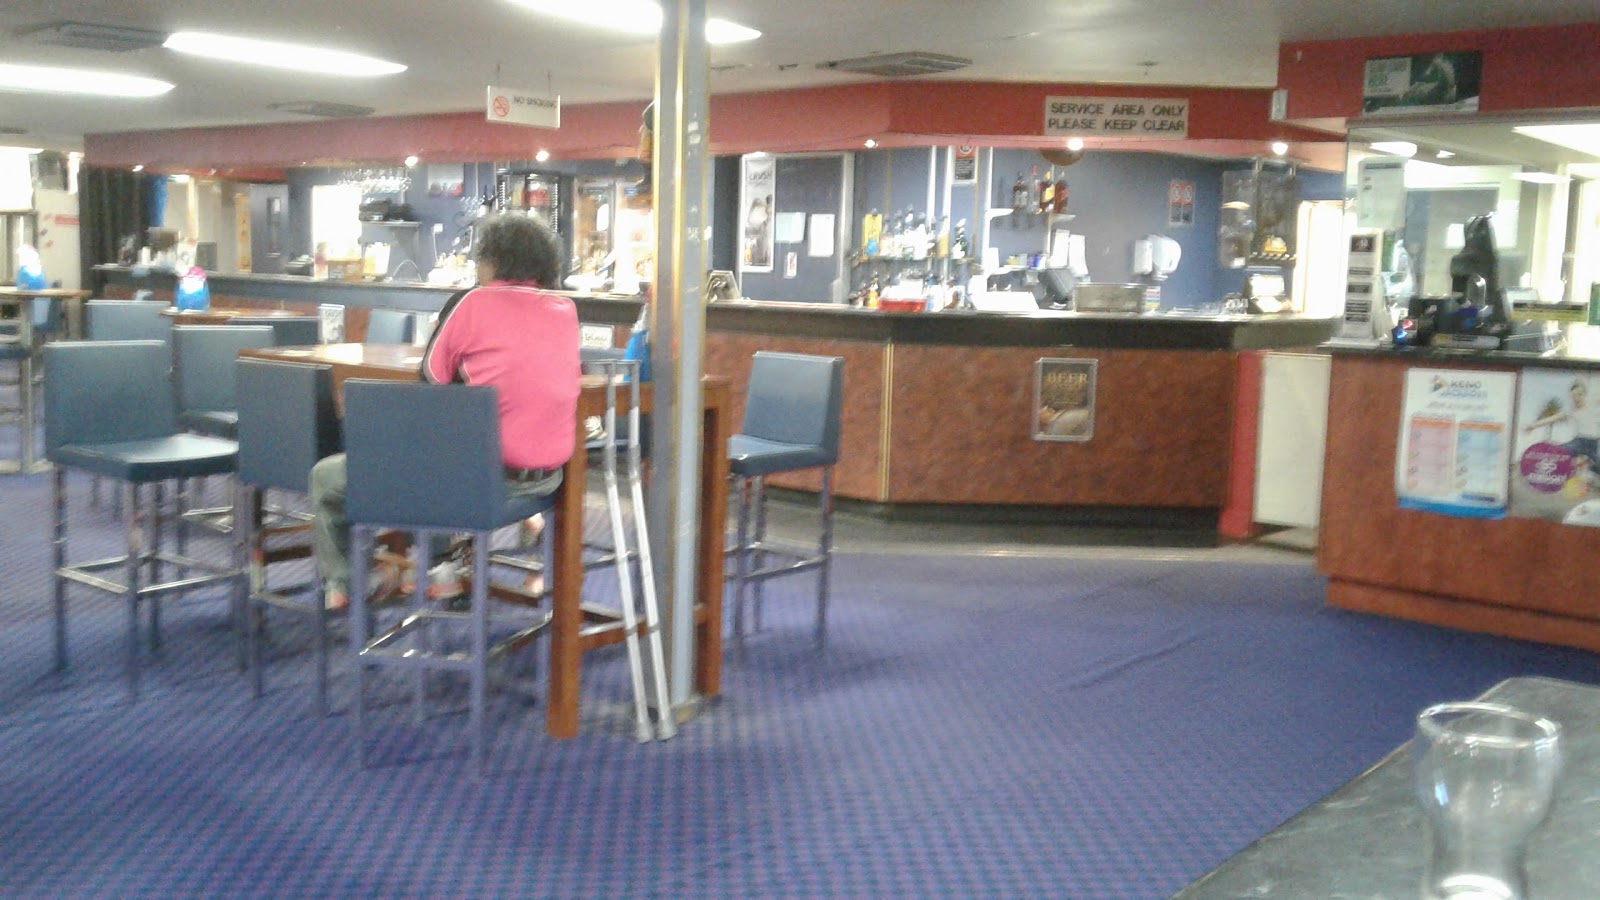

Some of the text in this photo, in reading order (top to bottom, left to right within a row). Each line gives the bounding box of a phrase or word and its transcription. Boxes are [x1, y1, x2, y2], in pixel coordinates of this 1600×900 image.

[1050, 102, 1186, 117] SERVICE AREA ONLY
[1048, 118, 1185, 132] PLEASE KEEP CLEAR
